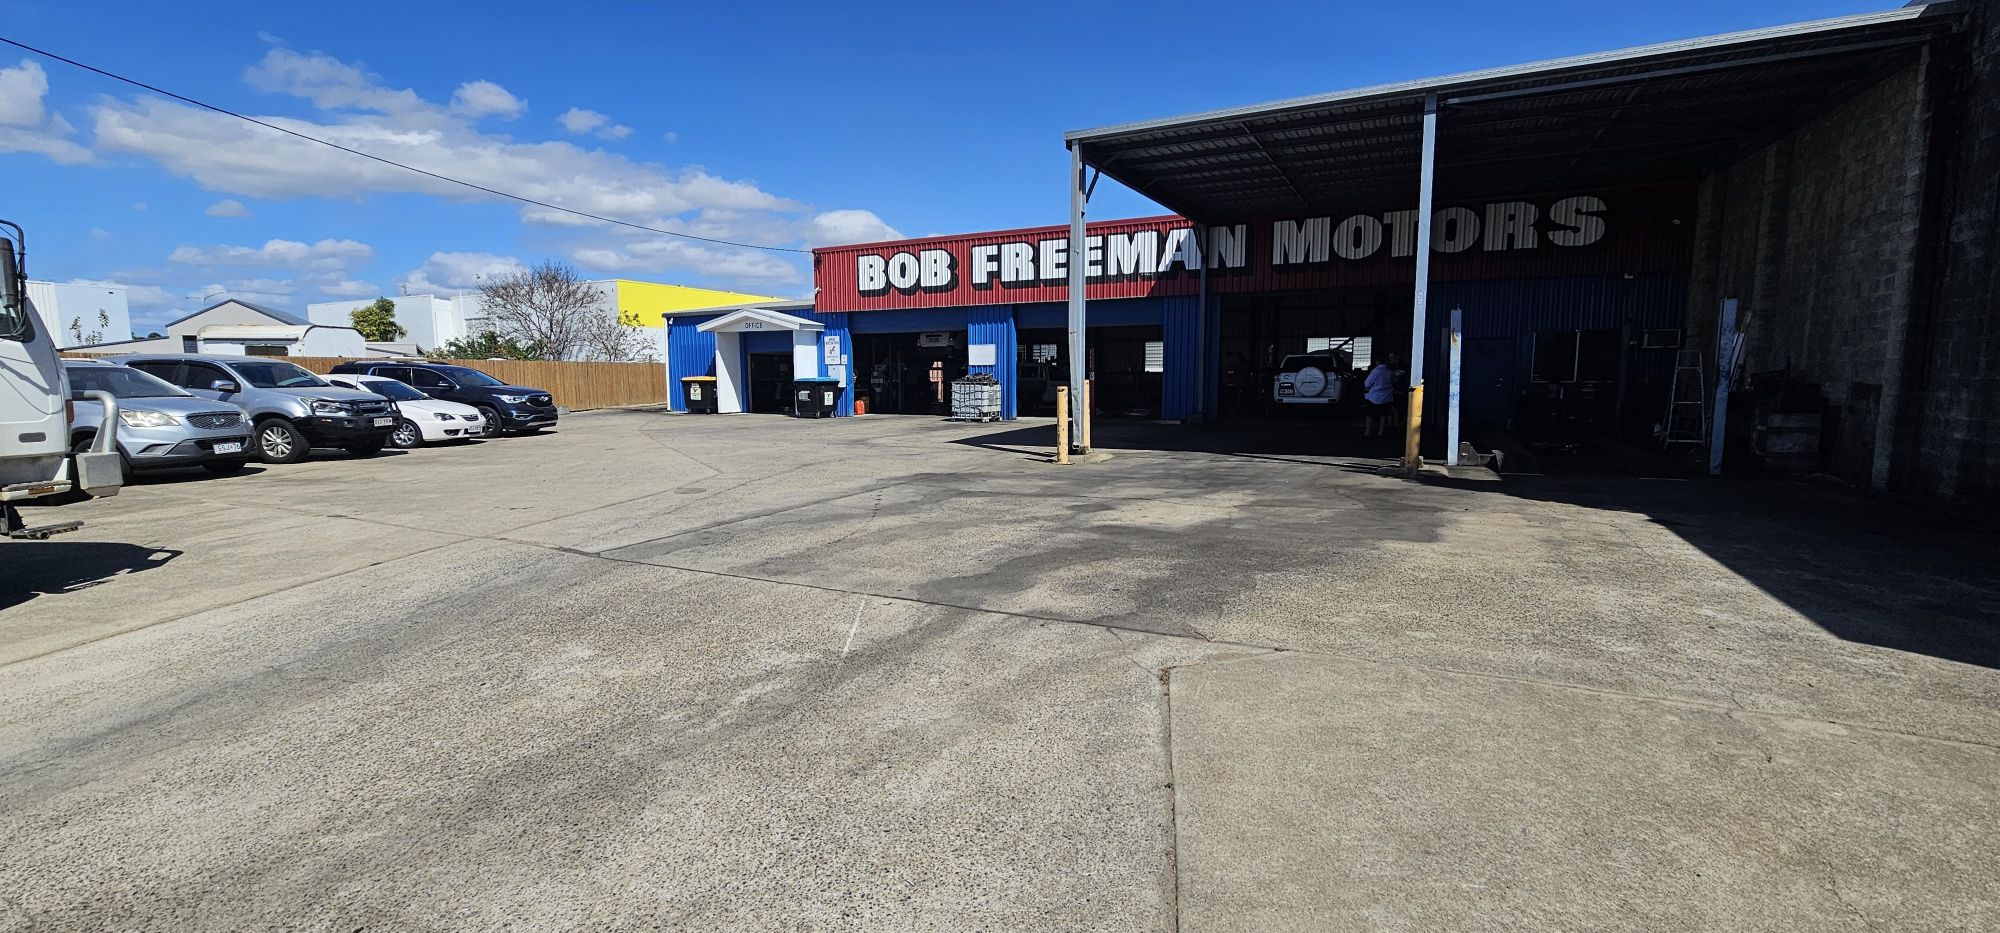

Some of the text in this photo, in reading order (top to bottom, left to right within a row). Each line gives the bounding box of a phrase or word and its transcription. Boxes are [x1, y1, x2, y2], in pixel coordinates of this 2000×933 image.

[857, 195, 1608, 294] BOB FREEMAN MOTORS
